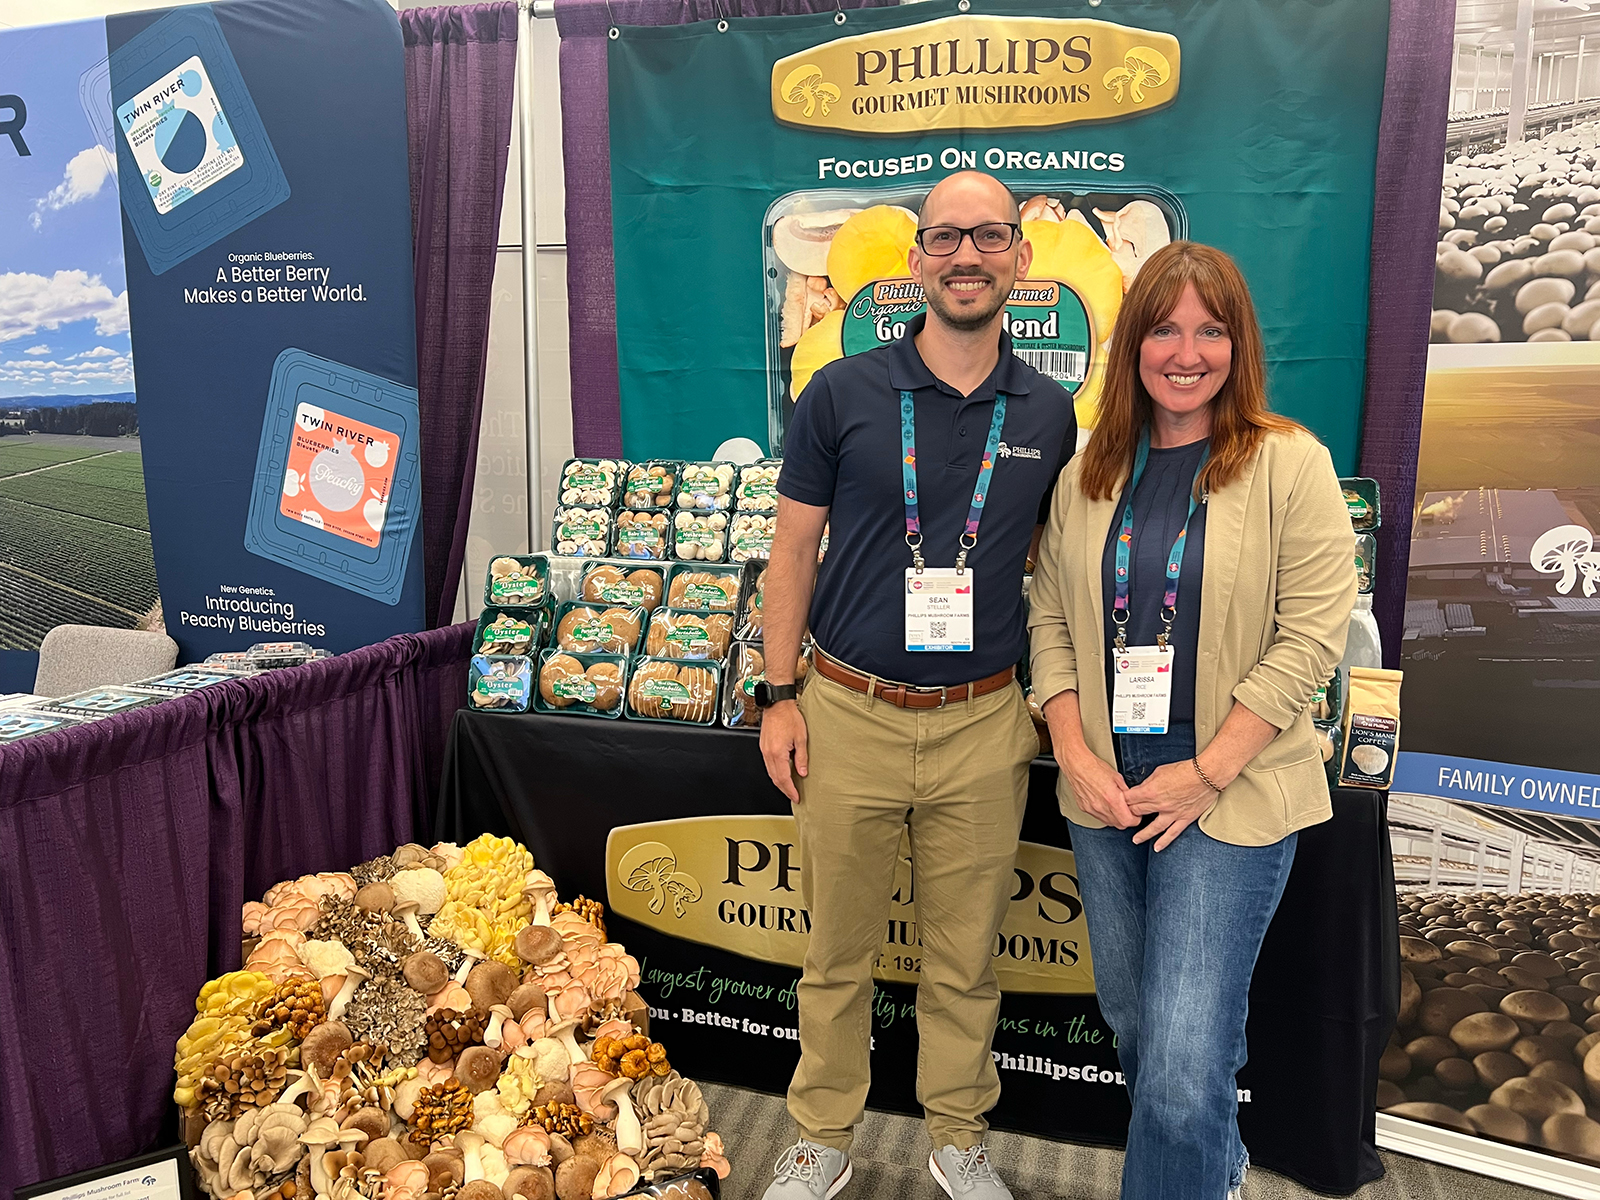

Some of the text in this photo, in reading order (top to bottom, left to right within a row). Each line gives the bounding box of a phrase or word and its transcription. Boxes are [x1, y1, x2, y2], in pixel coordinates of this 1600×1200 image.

[854, 35, 1092, 86] PHILLIPS
[124, 79, 185, 124] TWIN RIVER
[851, 84, 1091, 115] GOURMET MUSHROOMS
[132, 116, 168, 142] BLUEBERRIES
[228, 251, 315, 264] Organic Blueberries.
[216, 265, 330, 286] A Better Berry
[184, 284, 367, 303] Makes a Better World.
[878, 283, 1054, 300] Phillip urmet
[853, 296, 922, 324] Organic
[1003, 311, 1059, 338] lend
[302, 414, 374, 447] TWIN RIVER
[297, 436, 340, 455] BLUEBERRIES
[315, 463, 362, 496] Peachy
[220, 585, 275, 596] New Genetics.
[502, 581, 528, 590] Oyster
[205, 595, 294, 620] Introducing
[180, 611, 326, 637] Peachy Blueberries
[494, 628, 520, 637] Oyster
[487, 681, 513, 690] Oyster
[1358, 737, 1387, 746] COFFEE
[1438, 767, 1516, 796] FAMILY
[894, 956, 921, 972] 192
[640, 957, 711, 998] Largest
[709, 977, 775, 1003] grower
[1035, 1020, 1058, 1037] in
[1064, 1014, 1104, 1044] the
[648, 1005, 800, 1041] ou Better for ou
[87, 1182, 122, 1195] Mushroom
